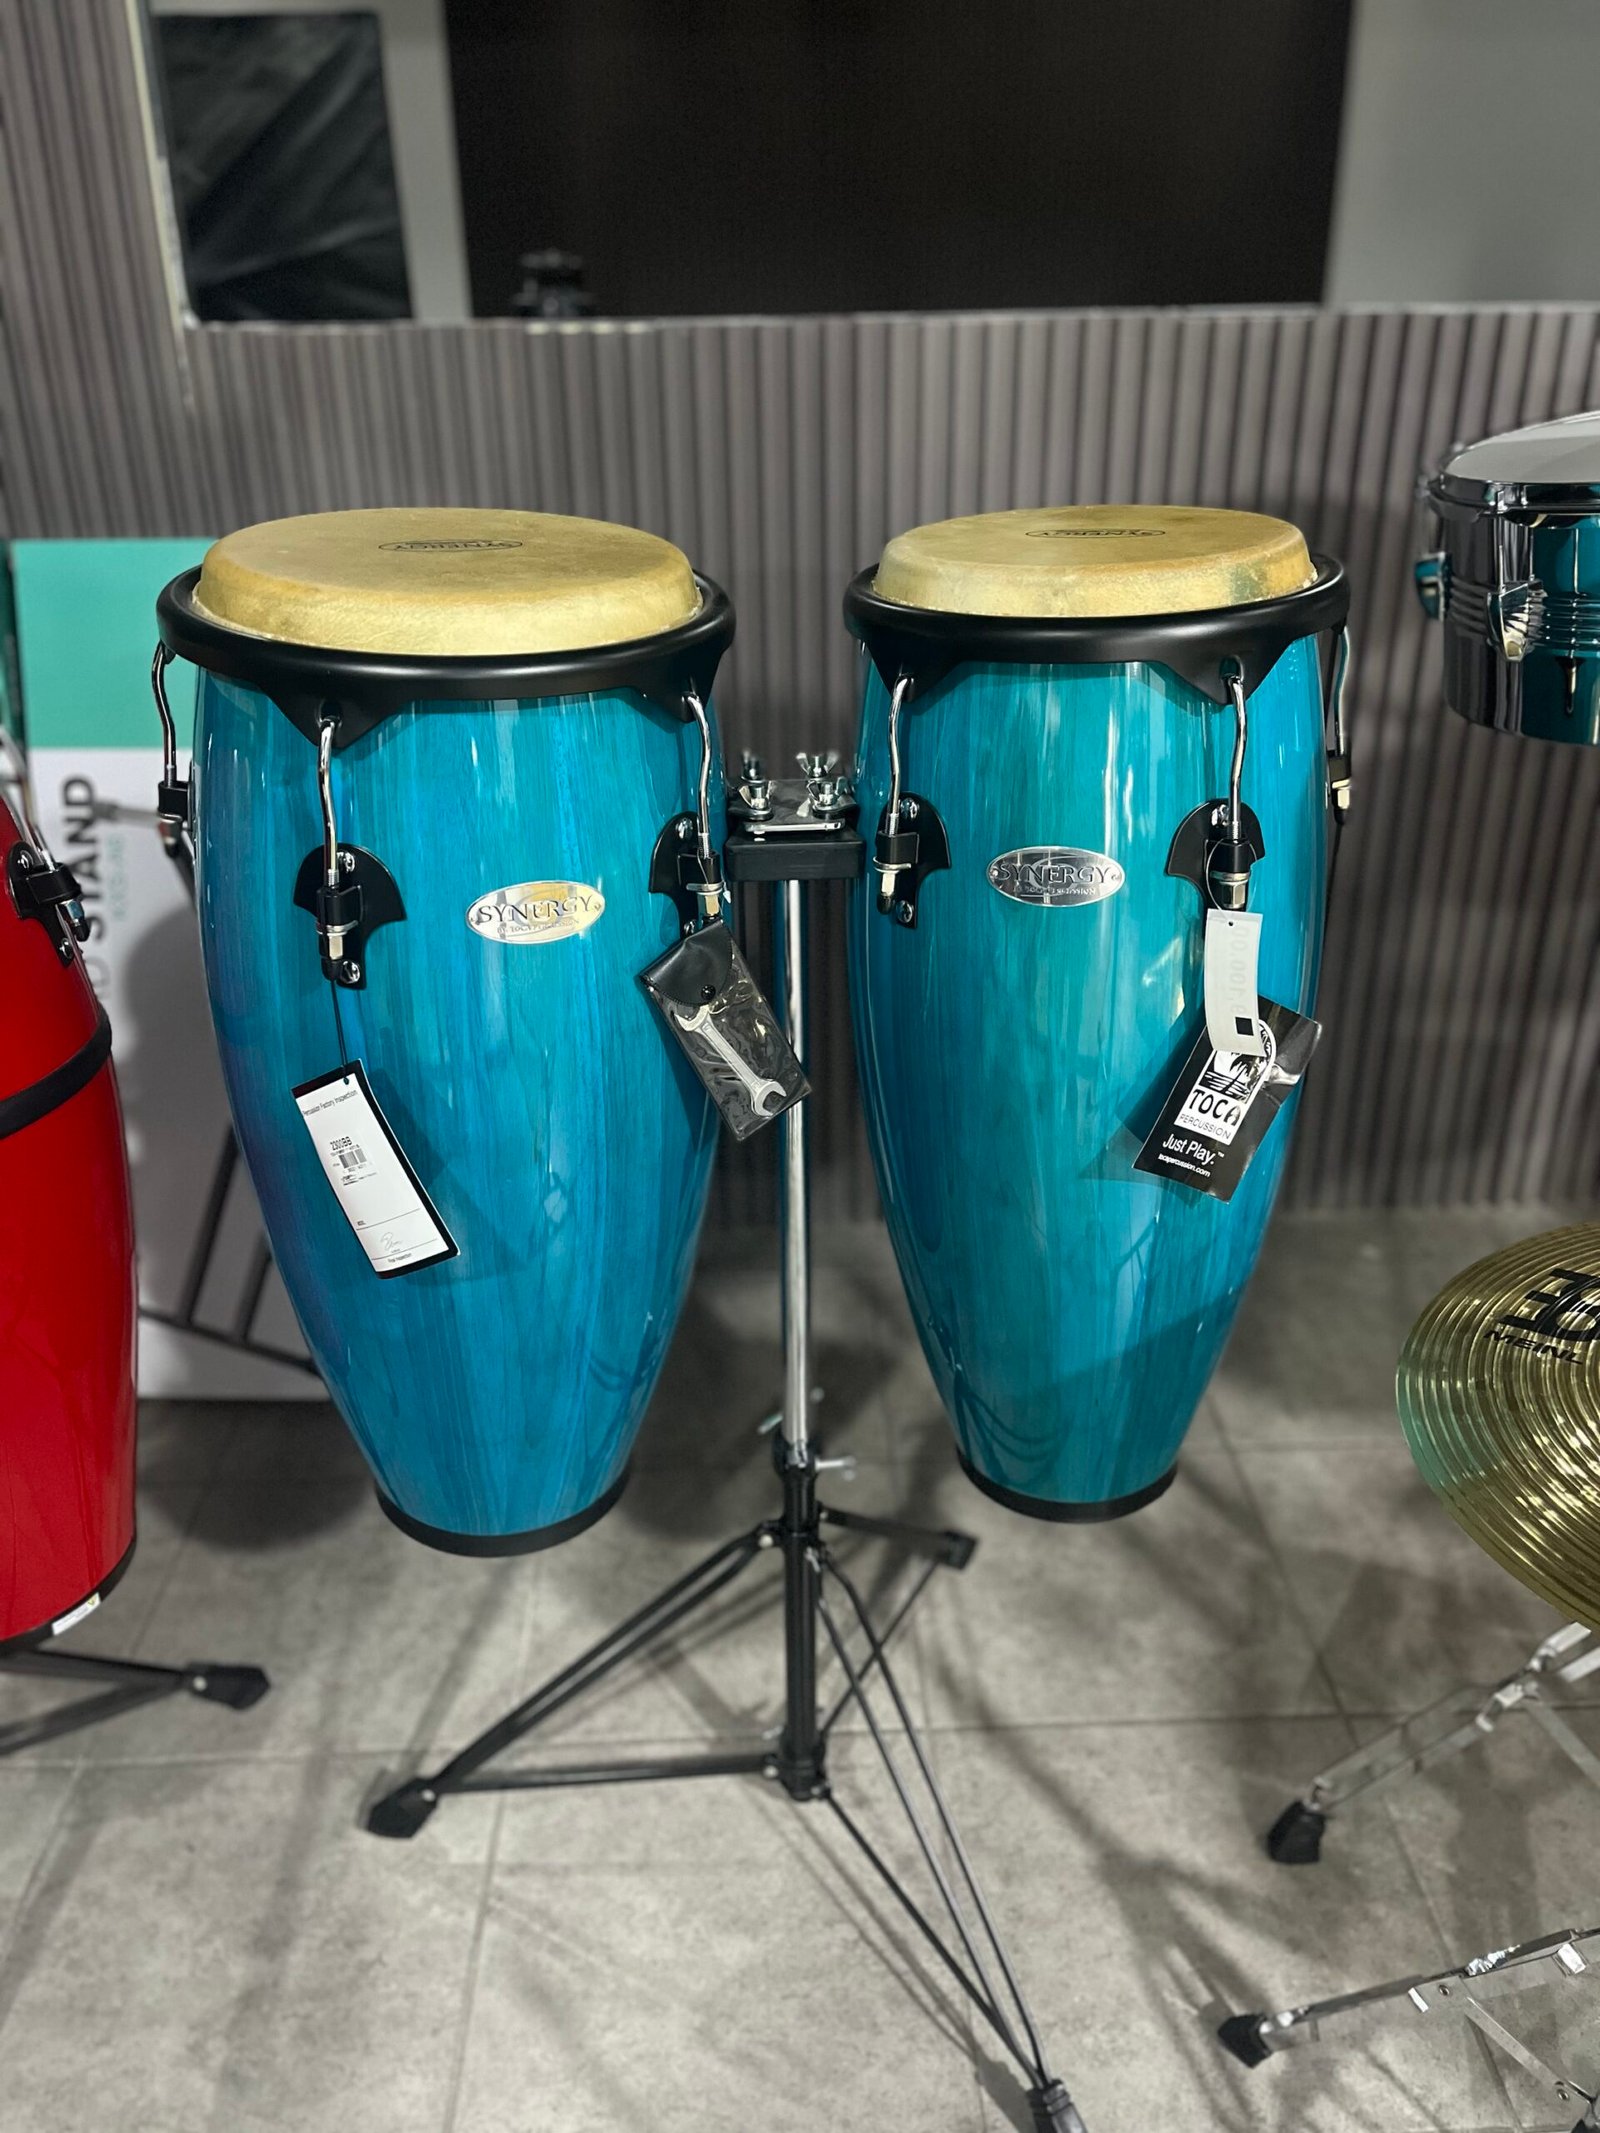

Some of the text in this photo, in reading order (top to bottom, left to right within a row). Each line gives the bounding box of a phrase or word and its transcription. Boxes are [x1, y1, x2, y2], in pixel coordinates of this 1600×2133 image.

[996, 862, 1110, 885] SYNERGY
[476, 894, 594, 924] SYNERGY
[1191, 1087, 1243, 1127] TOCA
[1178, 1114, 1233, 1141] PERCUSSION
[1162, 1132, 1188, 1155] Just
[1482, 1329, 1584, 1365] MEINL
